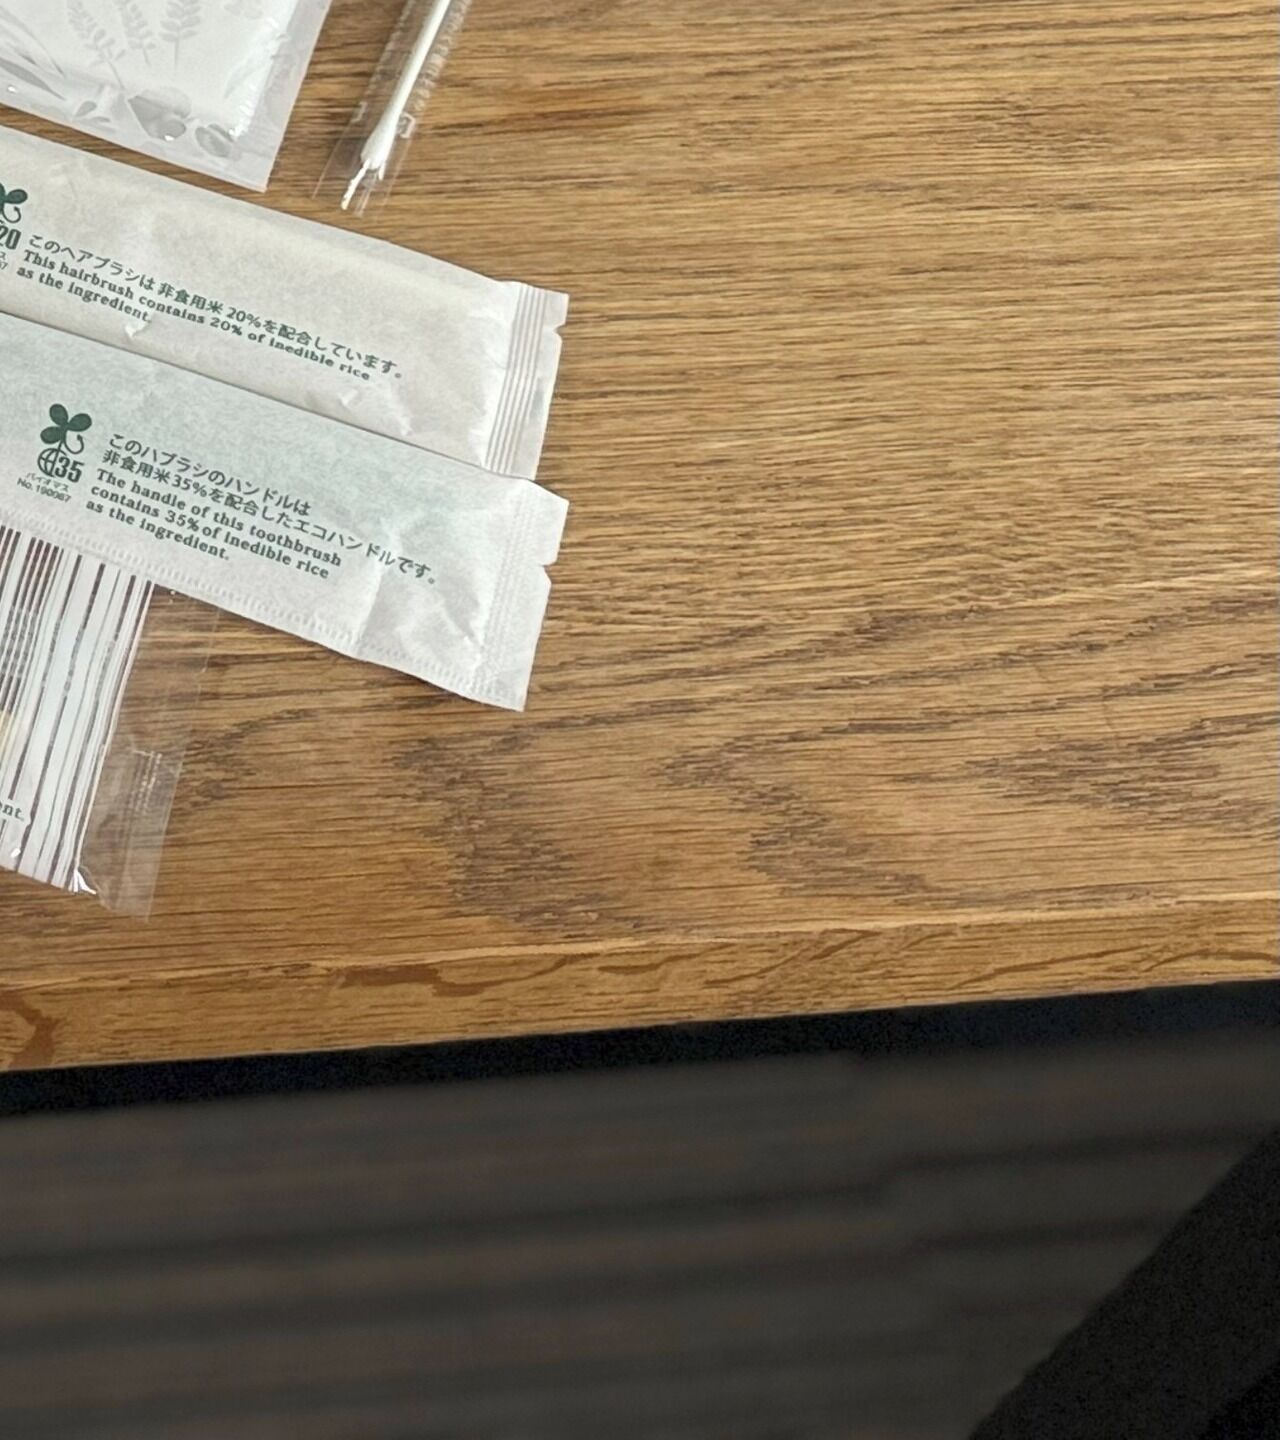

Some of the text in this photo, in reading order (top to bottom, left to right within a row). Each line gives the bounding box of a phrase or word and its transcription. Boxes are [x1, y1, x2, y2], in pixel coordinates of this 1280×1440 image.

[15, 266, 35, 280] as
[37, 272, 65, 291] the
[21, 248, 371, 382] This hairbrush contains 20% of inedible rice
[85, 499, 230, 562] as the ingredient.
[90, 485, 330, 580] contains 35% of inedible rice
[96, 467, 343, 568] The handle of this toothbrush
